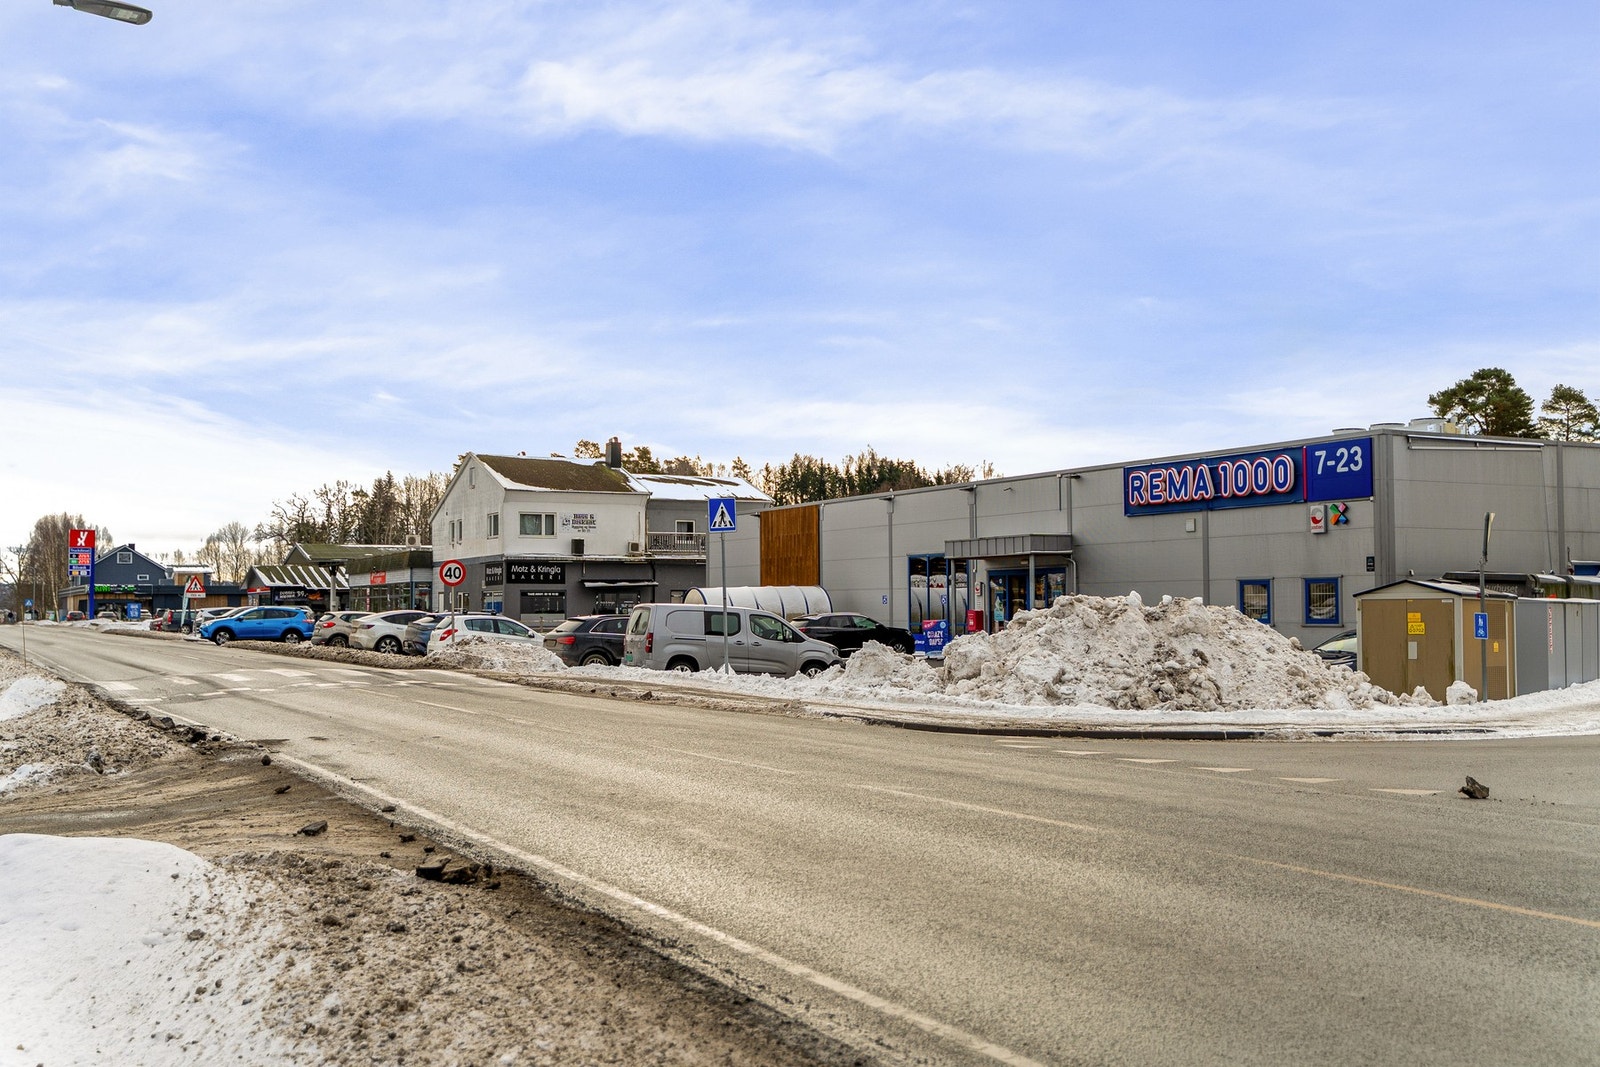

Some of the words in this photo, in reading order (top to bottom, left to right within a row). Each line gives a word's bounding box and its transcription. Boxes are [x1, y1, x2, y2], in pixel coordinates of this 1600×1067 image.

[1315, 446, 1363, 475] 7-23
[1129, 464, 1214, 506] REMA
[1218, 454, 1295, 498] 1000
[444, 567, 462, 579] 40
[511, 565, 528, 573] Motz
[530, 565, 536, 573] &
